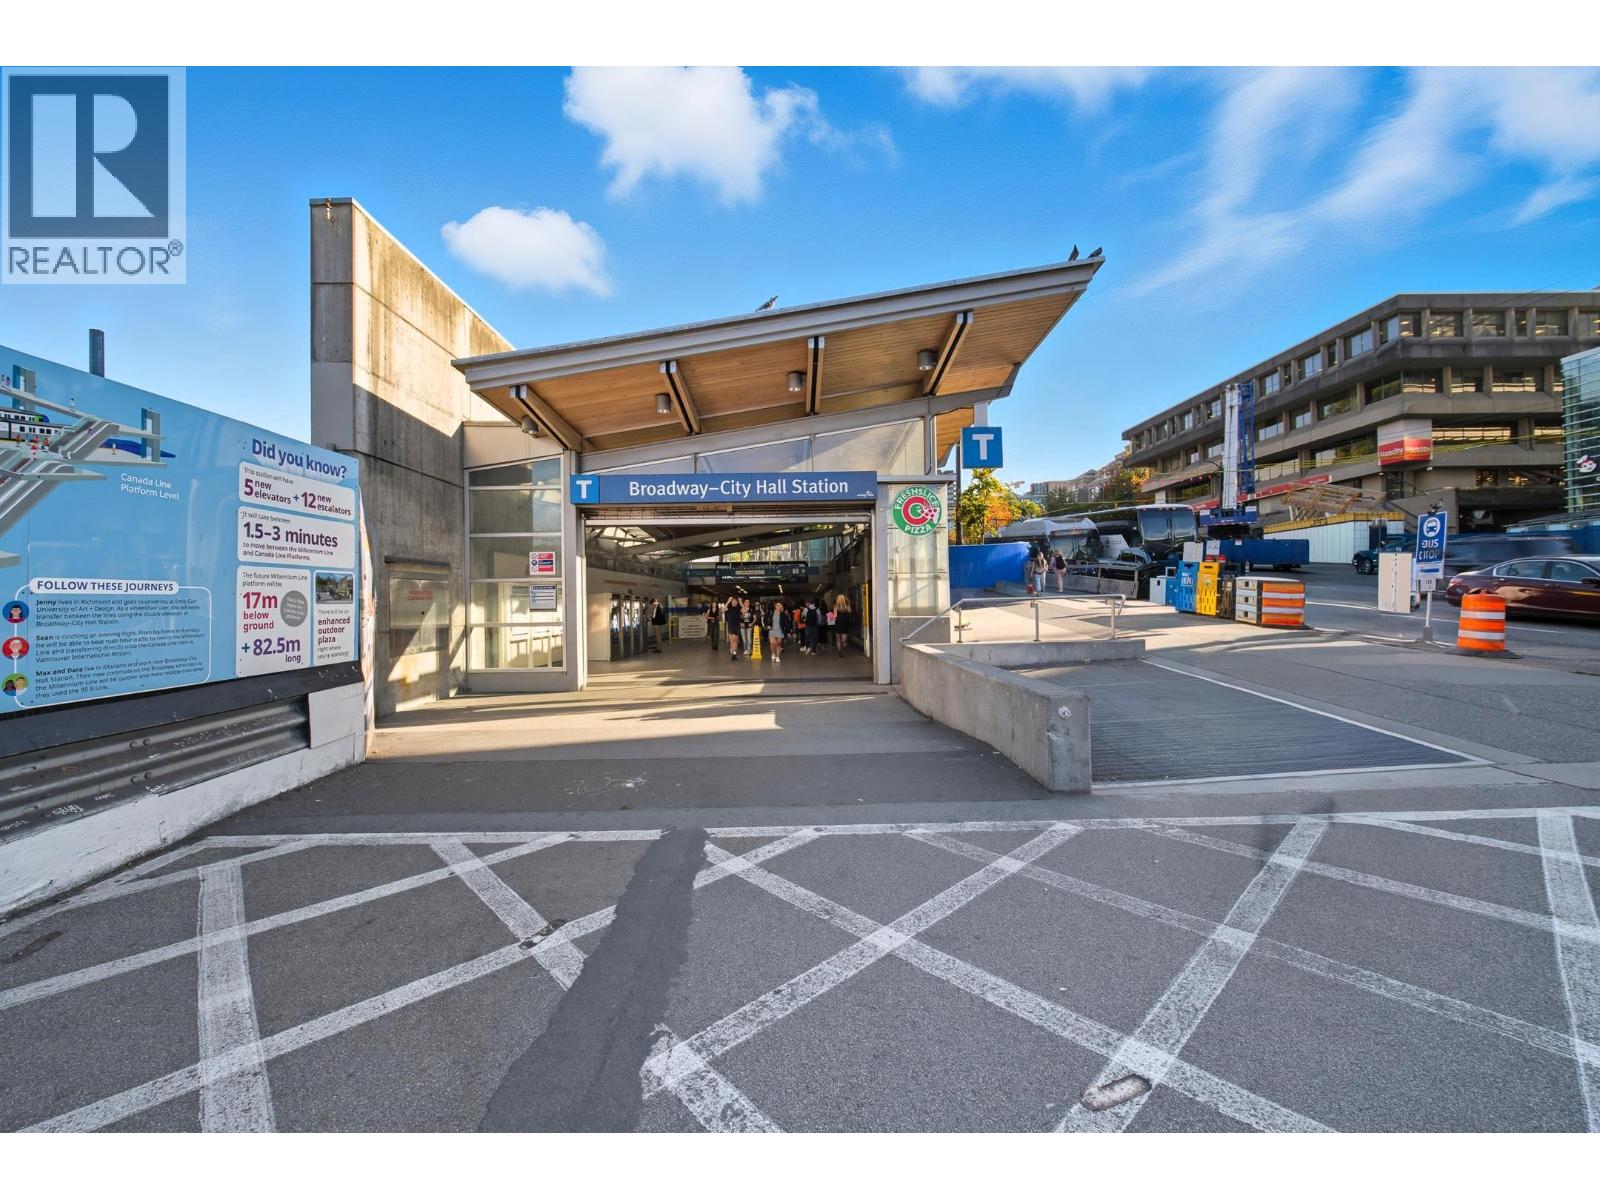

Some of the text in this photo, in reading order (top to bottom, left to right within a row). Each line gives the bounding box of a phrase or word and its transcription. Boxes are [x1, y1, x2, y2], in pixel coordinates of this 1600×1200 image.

[972, 434, 994, 460] T
[252, 438, 347, 478] Did you know?
[120, 472, 172, 488] Canada Line
[244, 478, 272, 496] 5 new
[120, 484, 179, 500] Platform Level
[576, 480, 592, 499] T
[756, 478, 786, 494] Hall
[792, 478, 848, 494] Station
[254, 490, 292, 504] elevators
[301, 492, 317, 509] 12
[318, 494, 332, 503] new
[894, 488, 940, 510] FRESHSLICE
[317, 504, 352, 516] escalators
[904, 524, 932, 534] PIZZA
[286, 529, 338, 548] minutes
[37, 580, 174, 592] FOLLOW THESE JOURNEYS
[243, 592, 278, 609] 17m
[243, 611, 269, 620] below
[318, 616, 350, 625] enhanced
[243, 620, 274, 632] ground
[318, 626, 345, 634] outdoor
[253, 637, 300, 656] 82.5m
[318, 636, 336, 646] plaza
[285, 655, 301, 663] long
